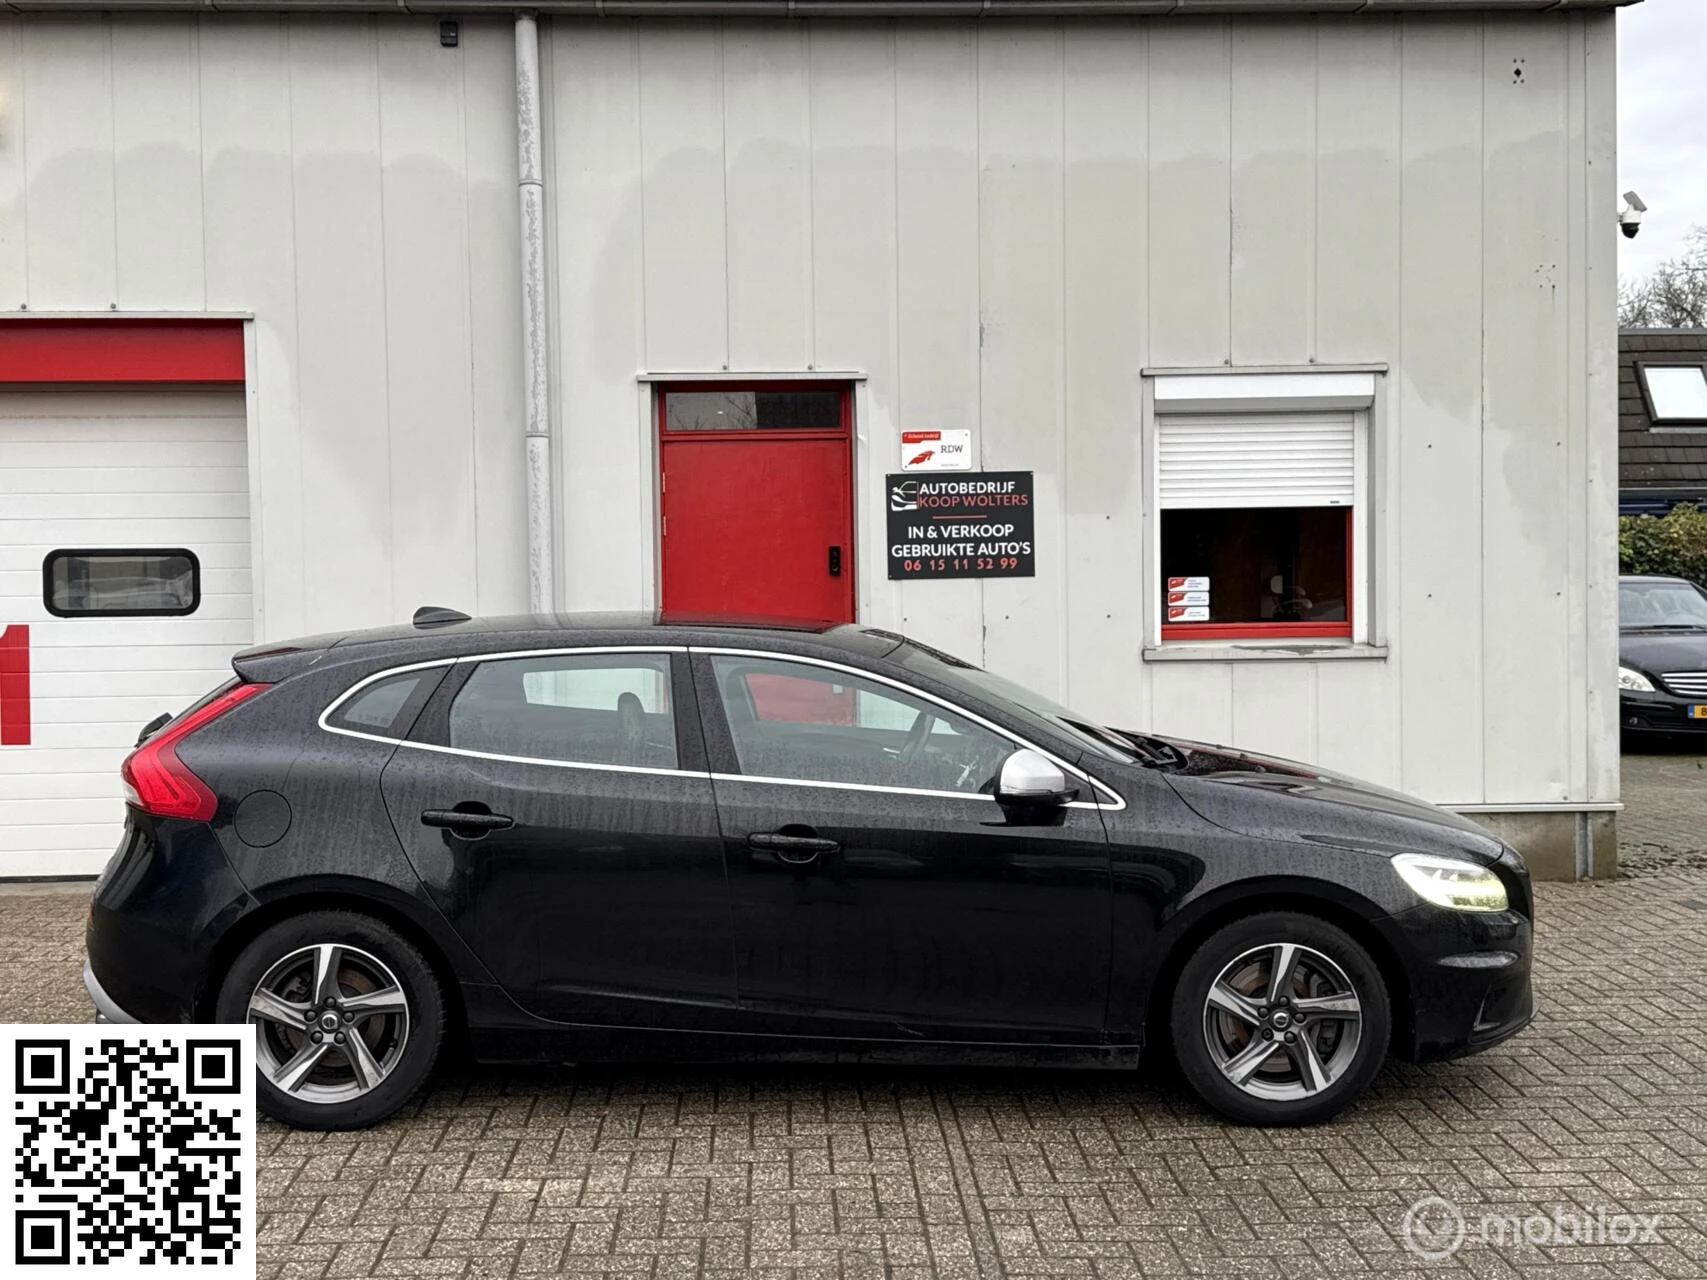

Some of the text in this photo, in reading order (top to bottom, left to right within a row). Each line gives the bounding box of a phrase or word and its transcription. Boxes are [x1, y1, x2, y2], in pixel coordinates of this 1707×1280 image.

[941, 445, 963, 453] RDW
[920, 482, 1015, 494] AUTOBEDRIJF
[919, 495, 1028, 507] KOOP WOLTERS
[908, 525, 1014, 538] IN & VERKOOP
[892, 542, 1031, 557] GEBRUIKTE AUTO'S
[904, 558, 1017, 570] 06 15 11 52 99
